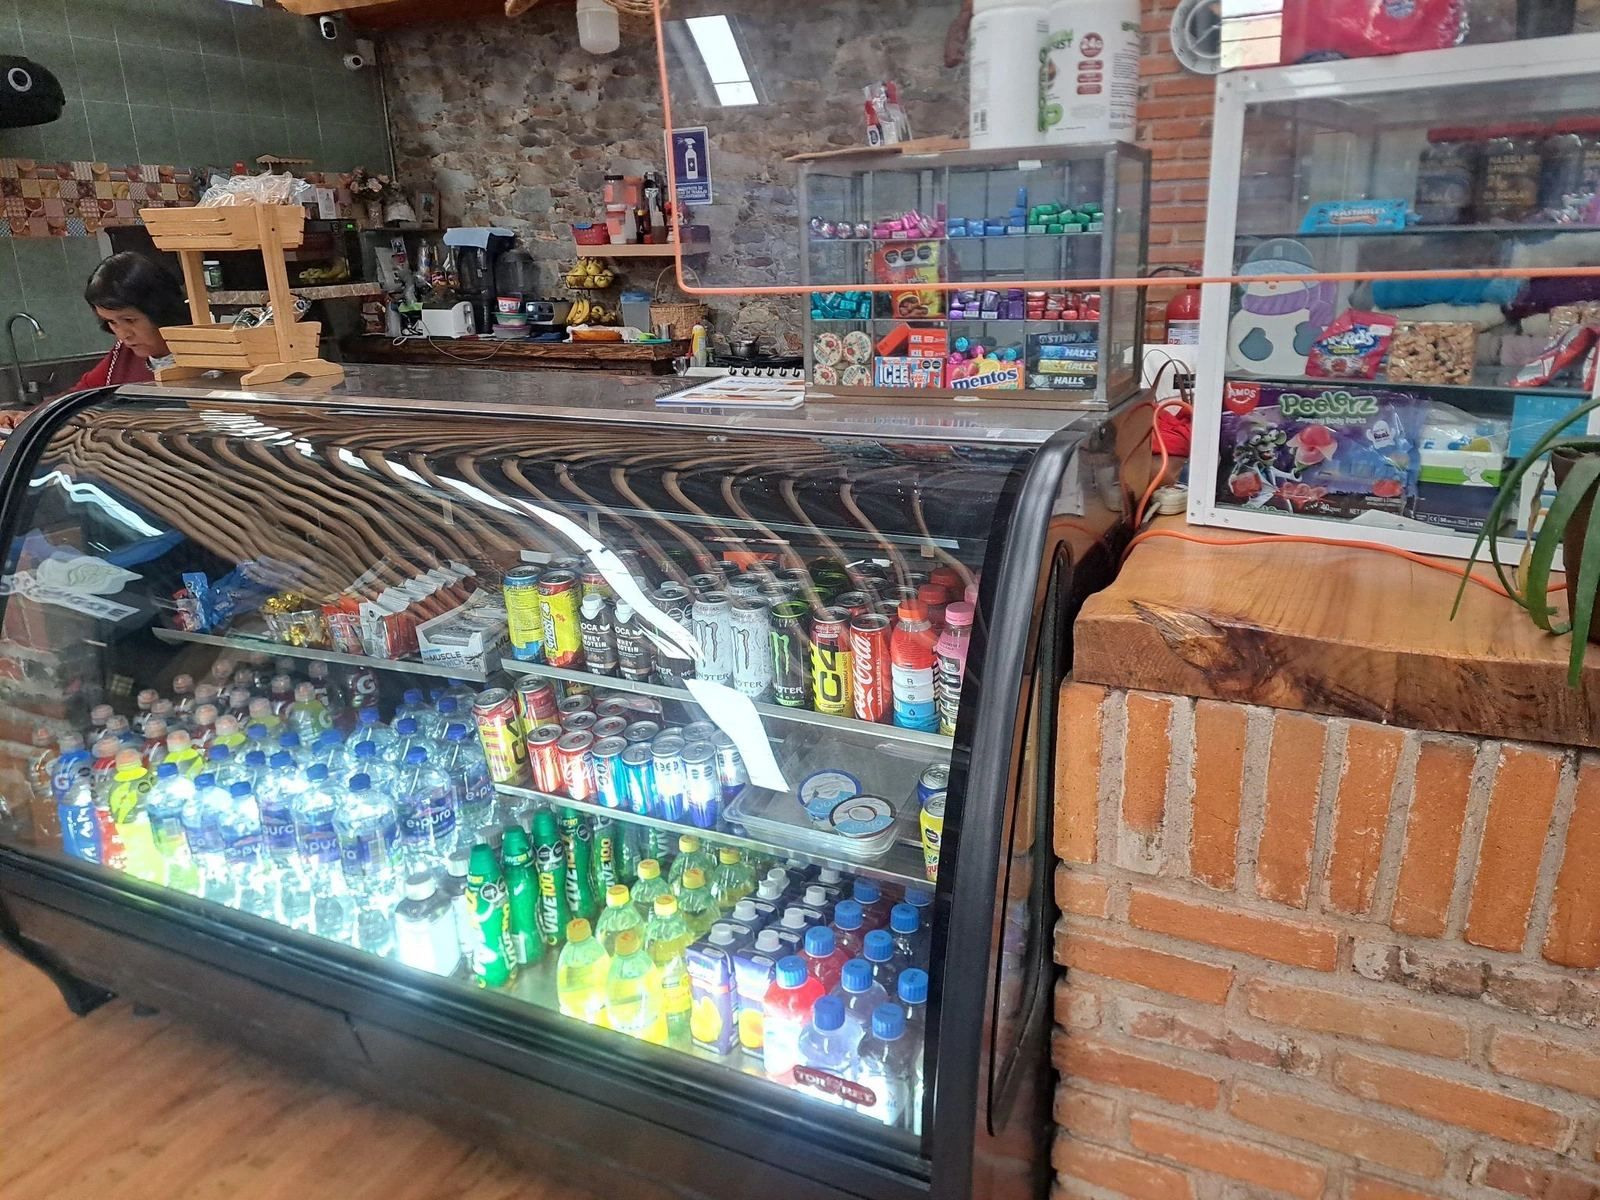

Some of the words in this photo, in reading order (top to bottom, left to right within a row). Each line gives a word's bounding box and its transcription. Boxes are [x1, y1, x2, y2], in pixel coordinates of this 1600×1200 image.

[1064, 348, 1097, 358] HALLS
[879, 363, 909, 385] ICEE
[1063, 362, 1096, 372] HALLS
[952, 367, 1017, 389] mentos
[1053, 376, 1085, 386] HALLS
[1227, 387, 1257, 399] AMOS
[429, 650, 462, 661] MUSCLE
[817, 640, 842, 703] C4
[356, 674, 376, 694] G
[319, 710, 333, 728] G
[540, 872, 559, 934] VIVE100
